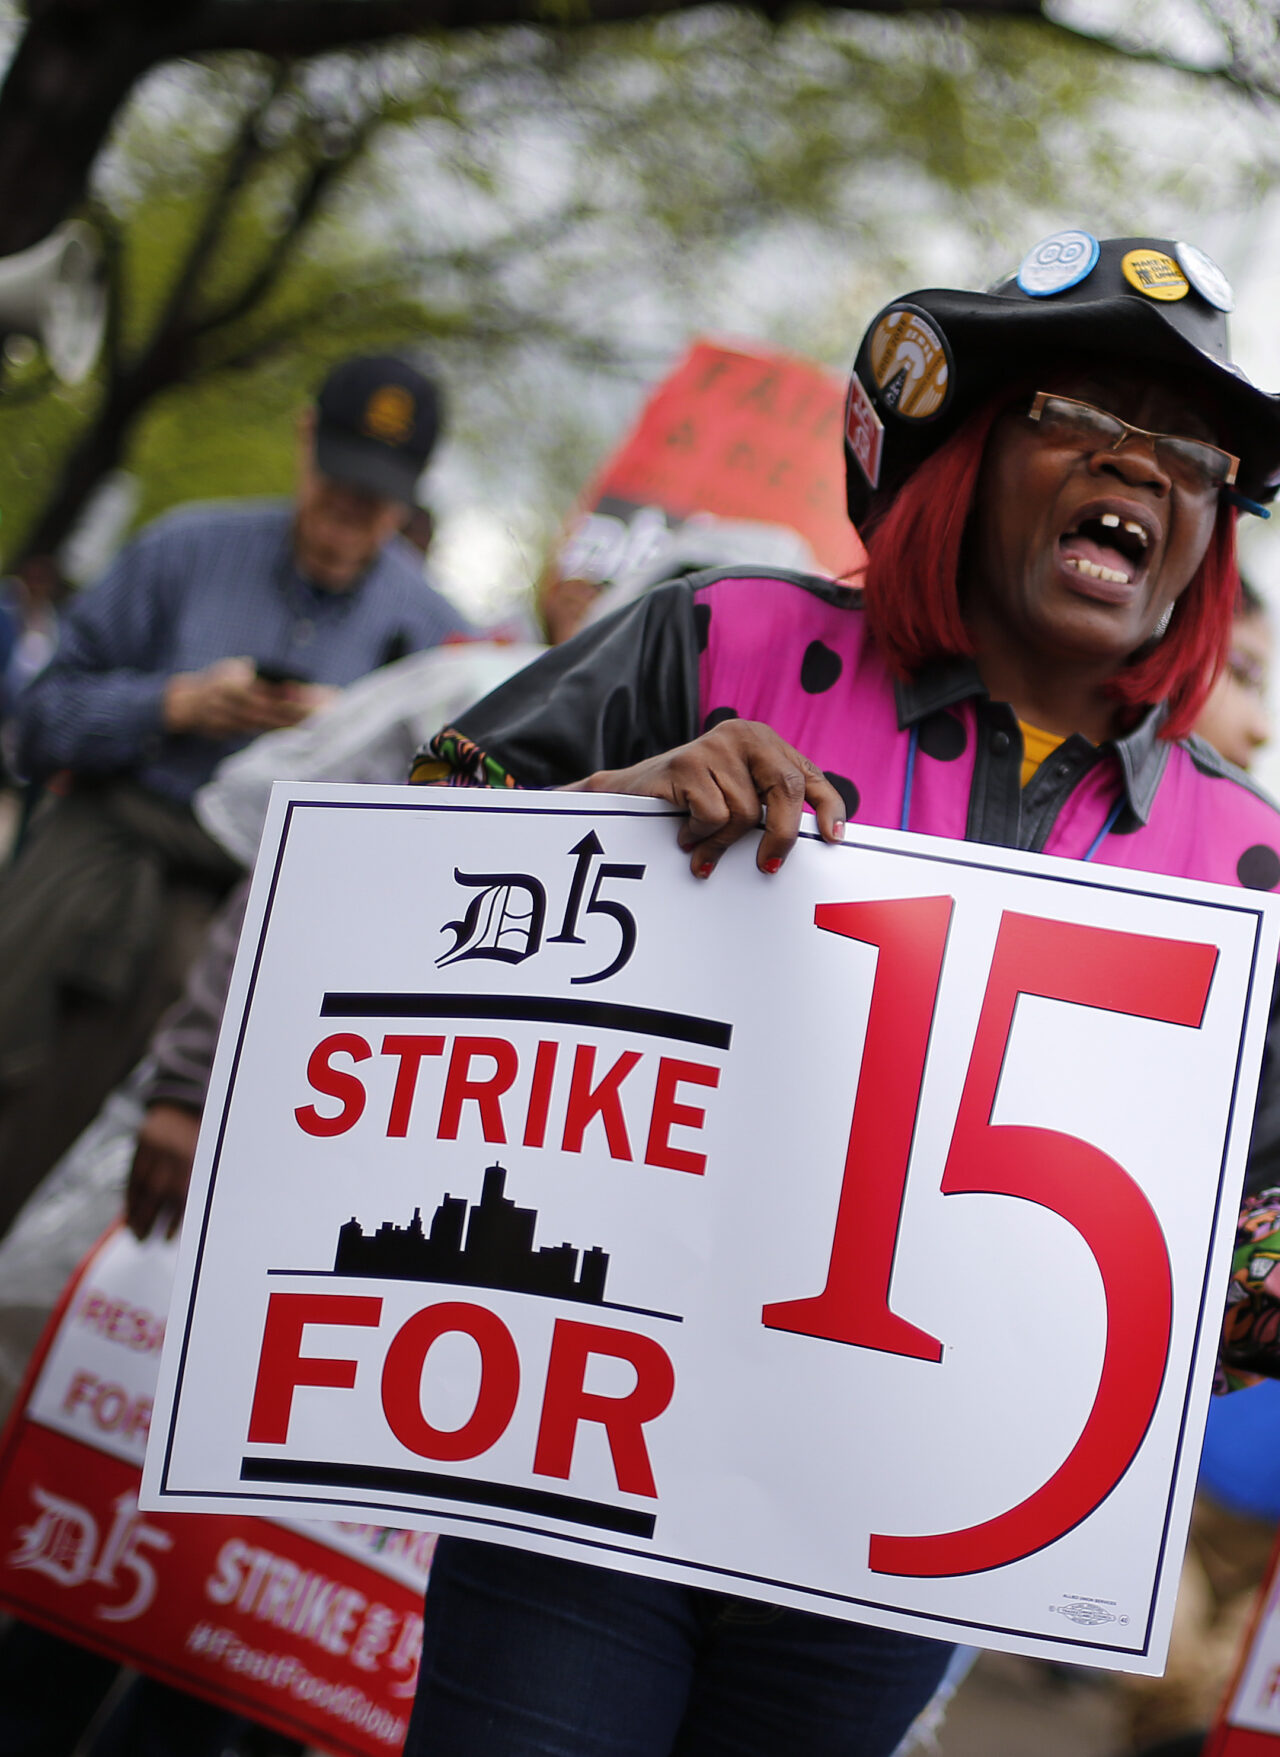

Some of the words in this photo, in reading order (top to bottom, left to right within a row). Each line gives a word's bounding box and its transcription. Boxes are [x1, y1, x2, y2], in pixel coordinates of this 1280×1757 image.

[294, 1033, 721, 1176] STRIKE
[761, 895, 1220, 1578] 15
[247, 1292, 676, 1500] FOR
[206, 1537, 367, 1655] STRIKE
